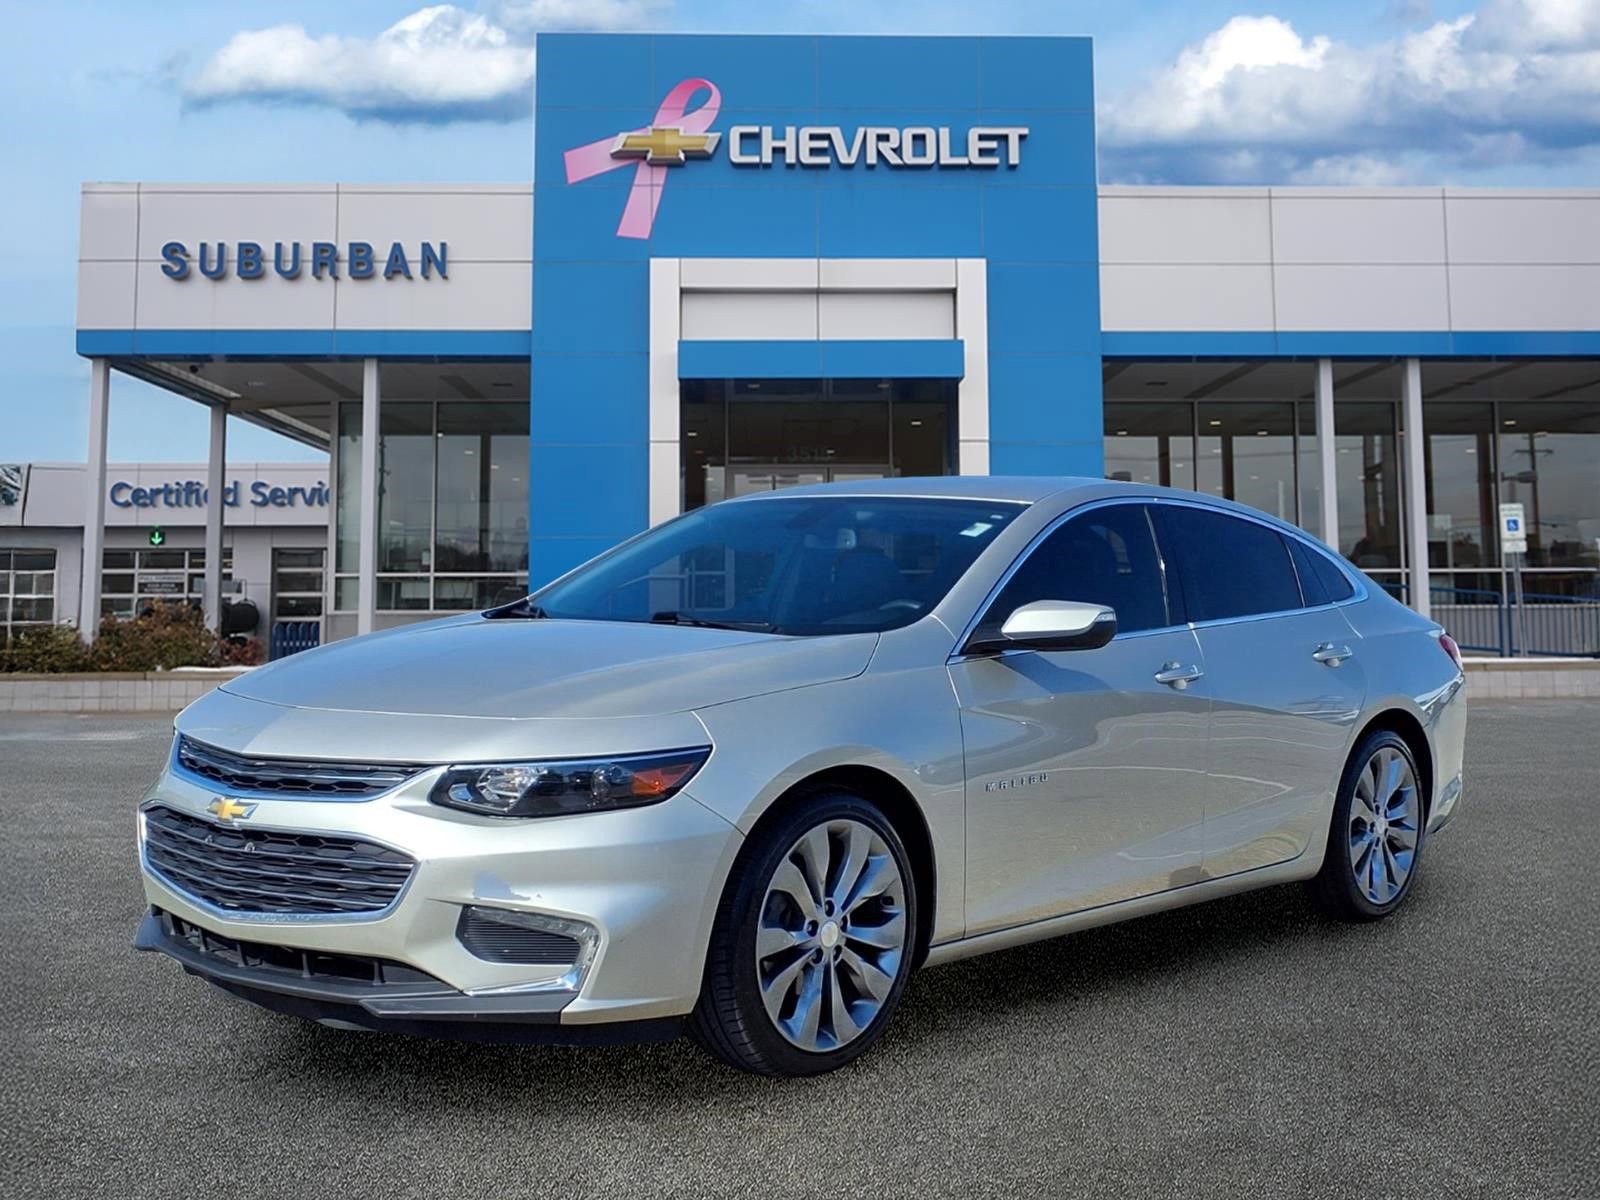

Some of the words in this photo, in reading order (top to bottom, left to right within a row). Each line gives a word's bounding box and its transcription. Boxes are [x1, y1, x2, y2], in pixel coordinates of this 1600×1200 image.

[729, 125, 1029, 168] CHEVROLET
[161, 241, 448, 281] SUBURBAN
[984, 772, 1049, 792] MALIBU
